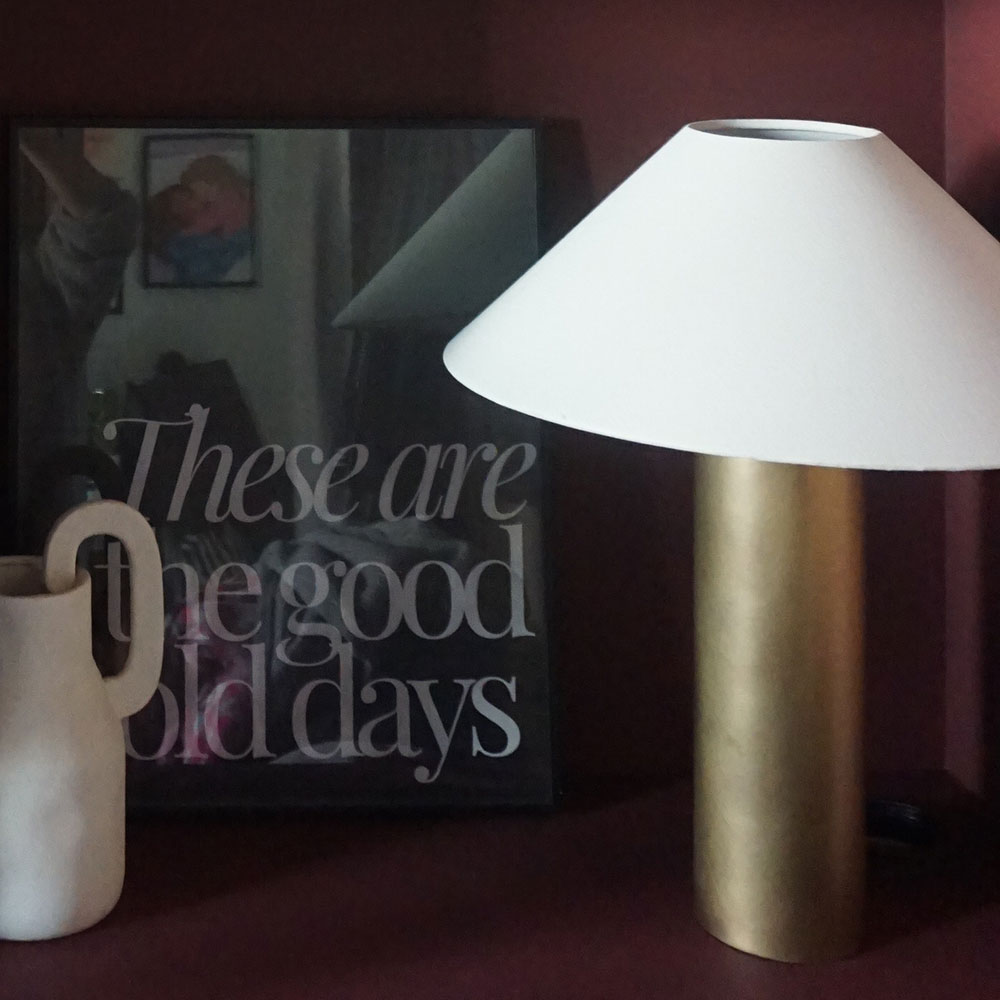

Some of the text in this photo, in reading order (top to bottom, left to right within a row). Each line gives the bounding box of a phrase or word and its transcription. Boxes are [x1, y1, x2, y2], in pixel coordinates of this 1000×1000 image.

[103, 403, 537, 523] These are
[276, 524, 535, 667] good
[123, 642, 521, 783] old days
